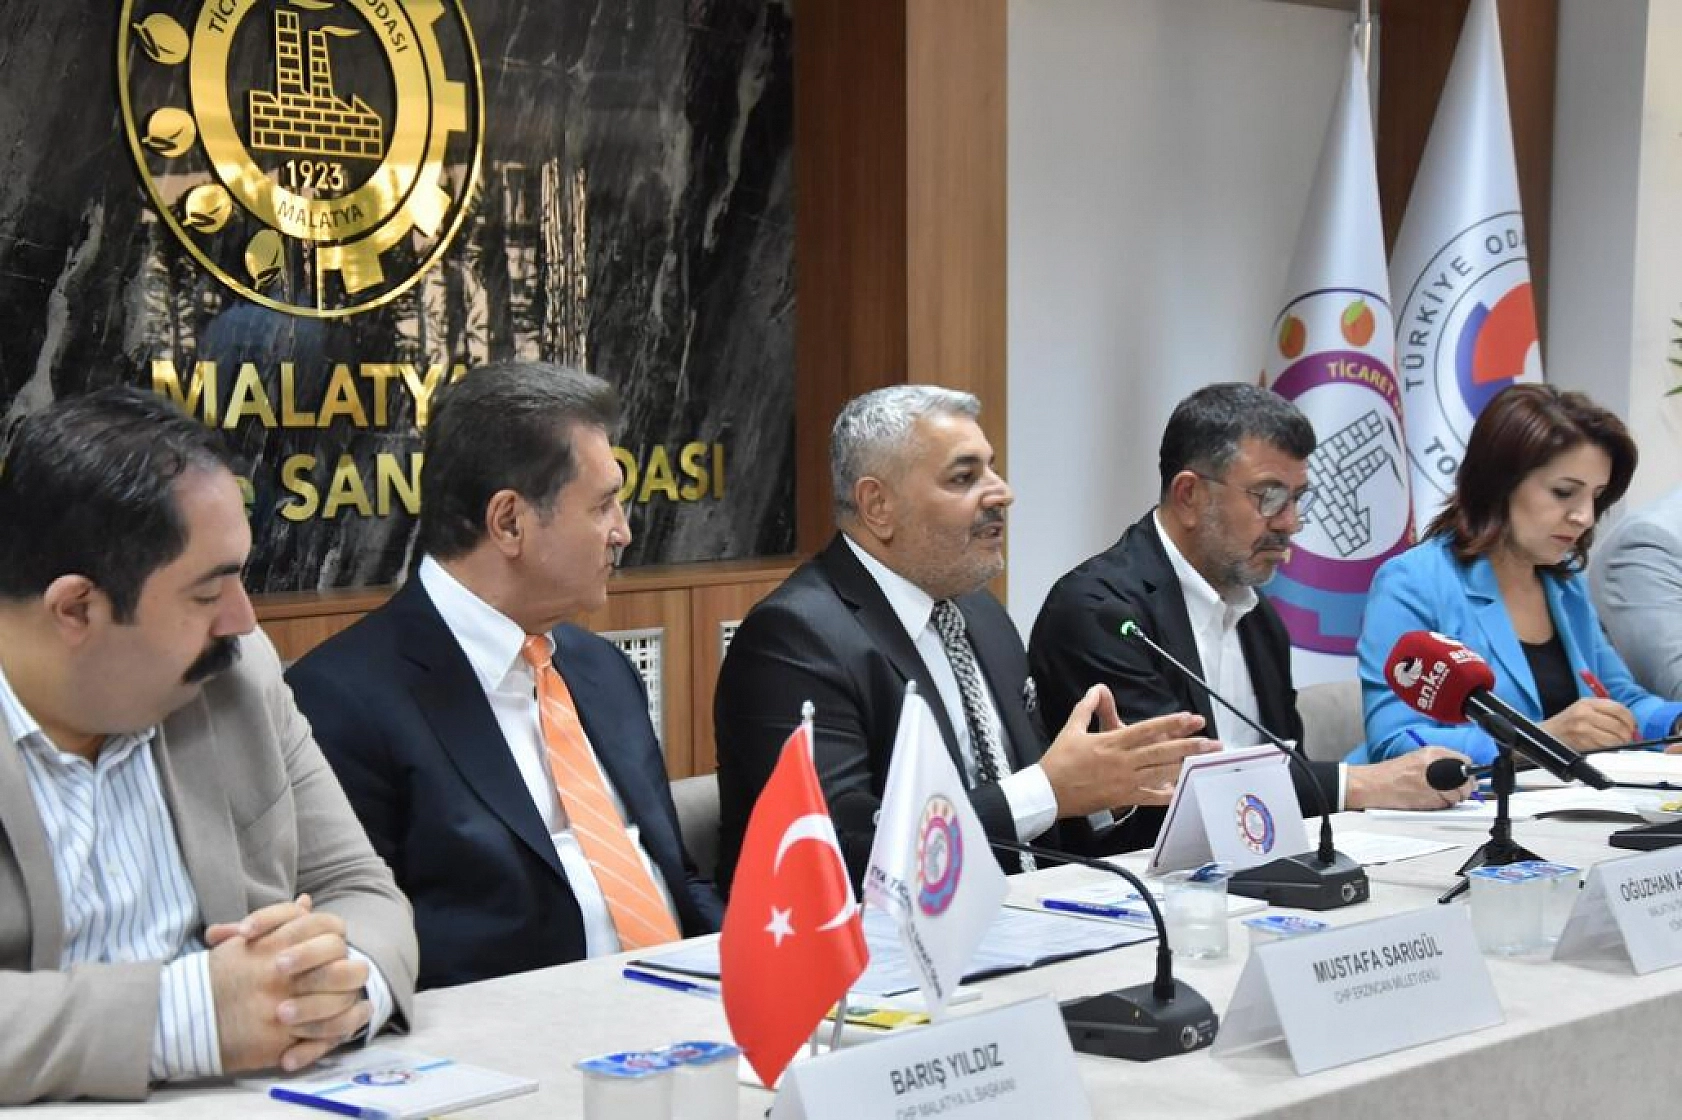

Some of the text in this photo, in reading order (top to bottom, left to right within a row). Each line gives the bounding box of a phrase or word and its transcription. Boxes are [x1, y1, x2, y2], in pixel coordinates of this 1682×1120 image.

[285, 159, 345, 191] 1923
[277, 200, 364, 230] MALATYA
[1402, 256, 1474, 392] TÜRKİYE
[1326, 358, 1394, 396] TİCARET
[1424, 436, 1457, 476] TO
[279, 453, 425, 521] SAN
[610, 440, 725, 503] DASI
[1619, 873, 1675, 902] OĞUZHAN
[1312, 932, 1443, 984] MUSTAFA SARIGÜL
[889, 1042, 1004, 1095] BARIŞ YILDIZ
